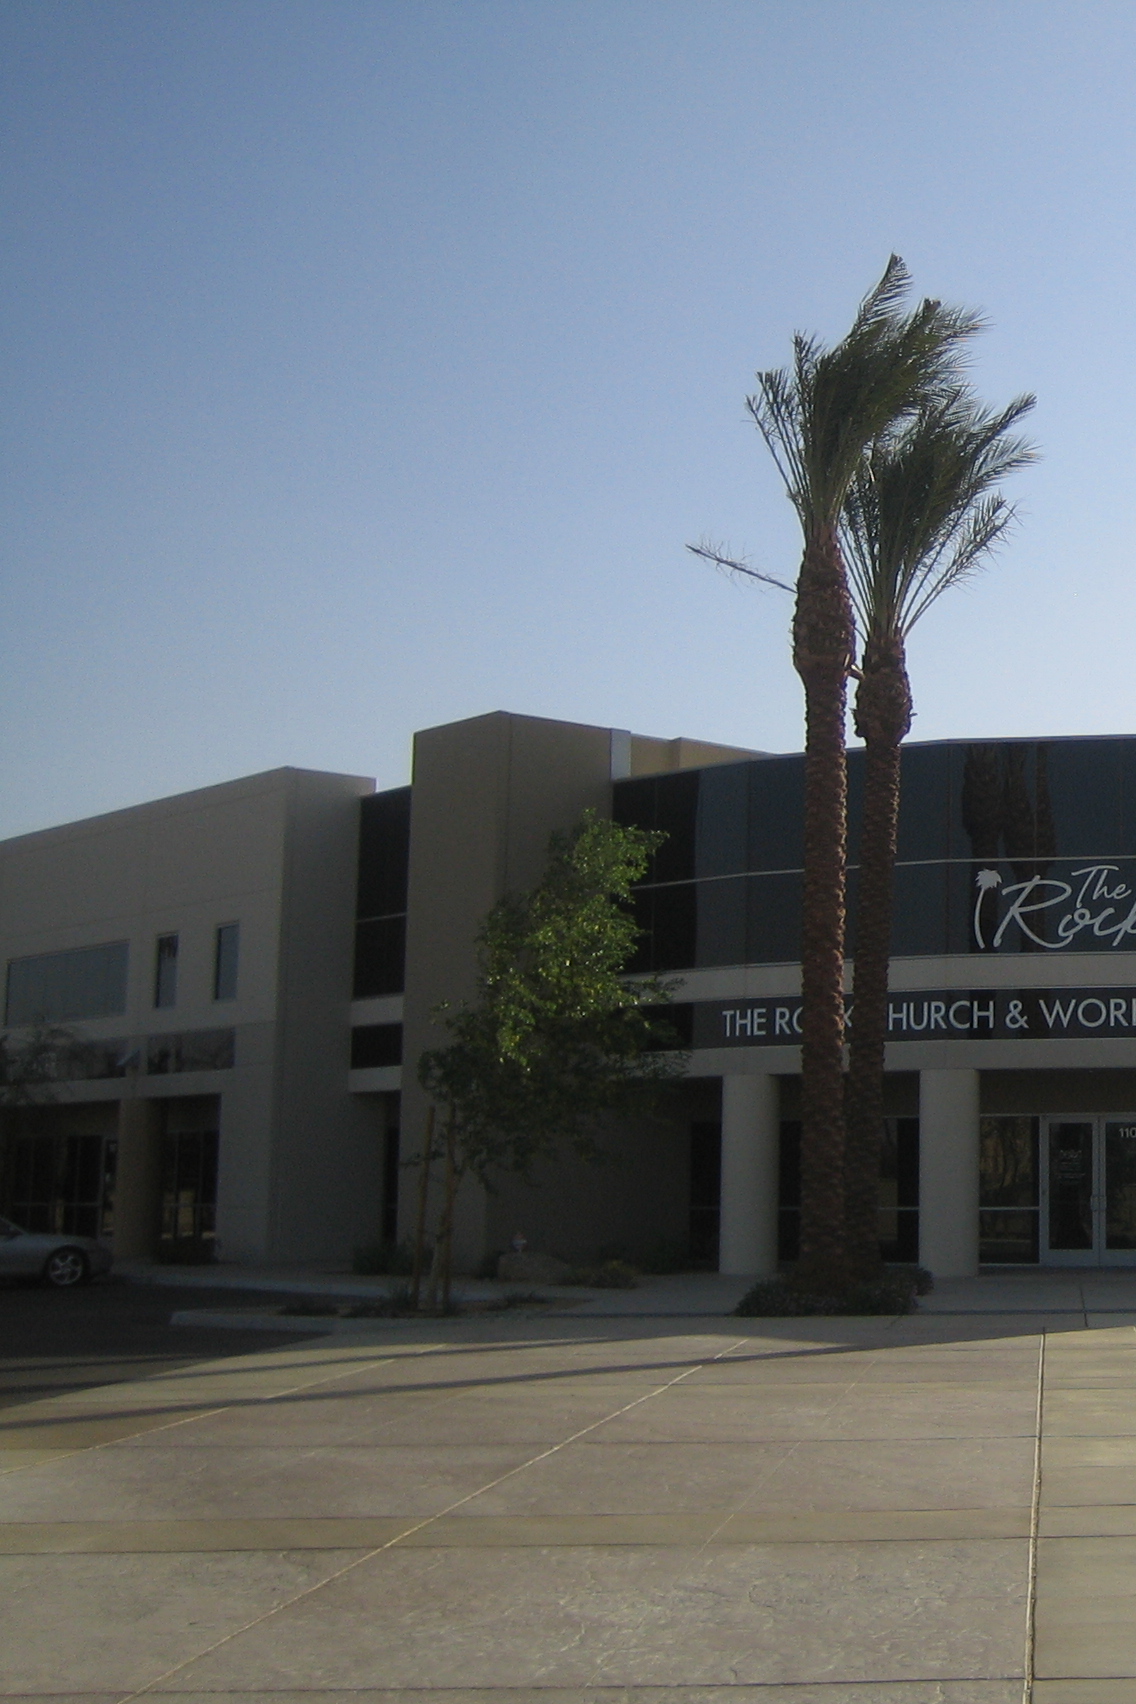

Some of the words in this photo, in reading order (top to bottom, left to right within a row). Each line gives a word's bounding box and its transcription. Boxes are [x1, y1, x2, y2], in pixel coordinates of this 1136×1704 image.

[1071, 865, 1132, 908] The
[722, 1007, 767, 1037] THE
[888, 1000, 995, 1031] HURCH
[1004, 1000, 1030, 1029] &
